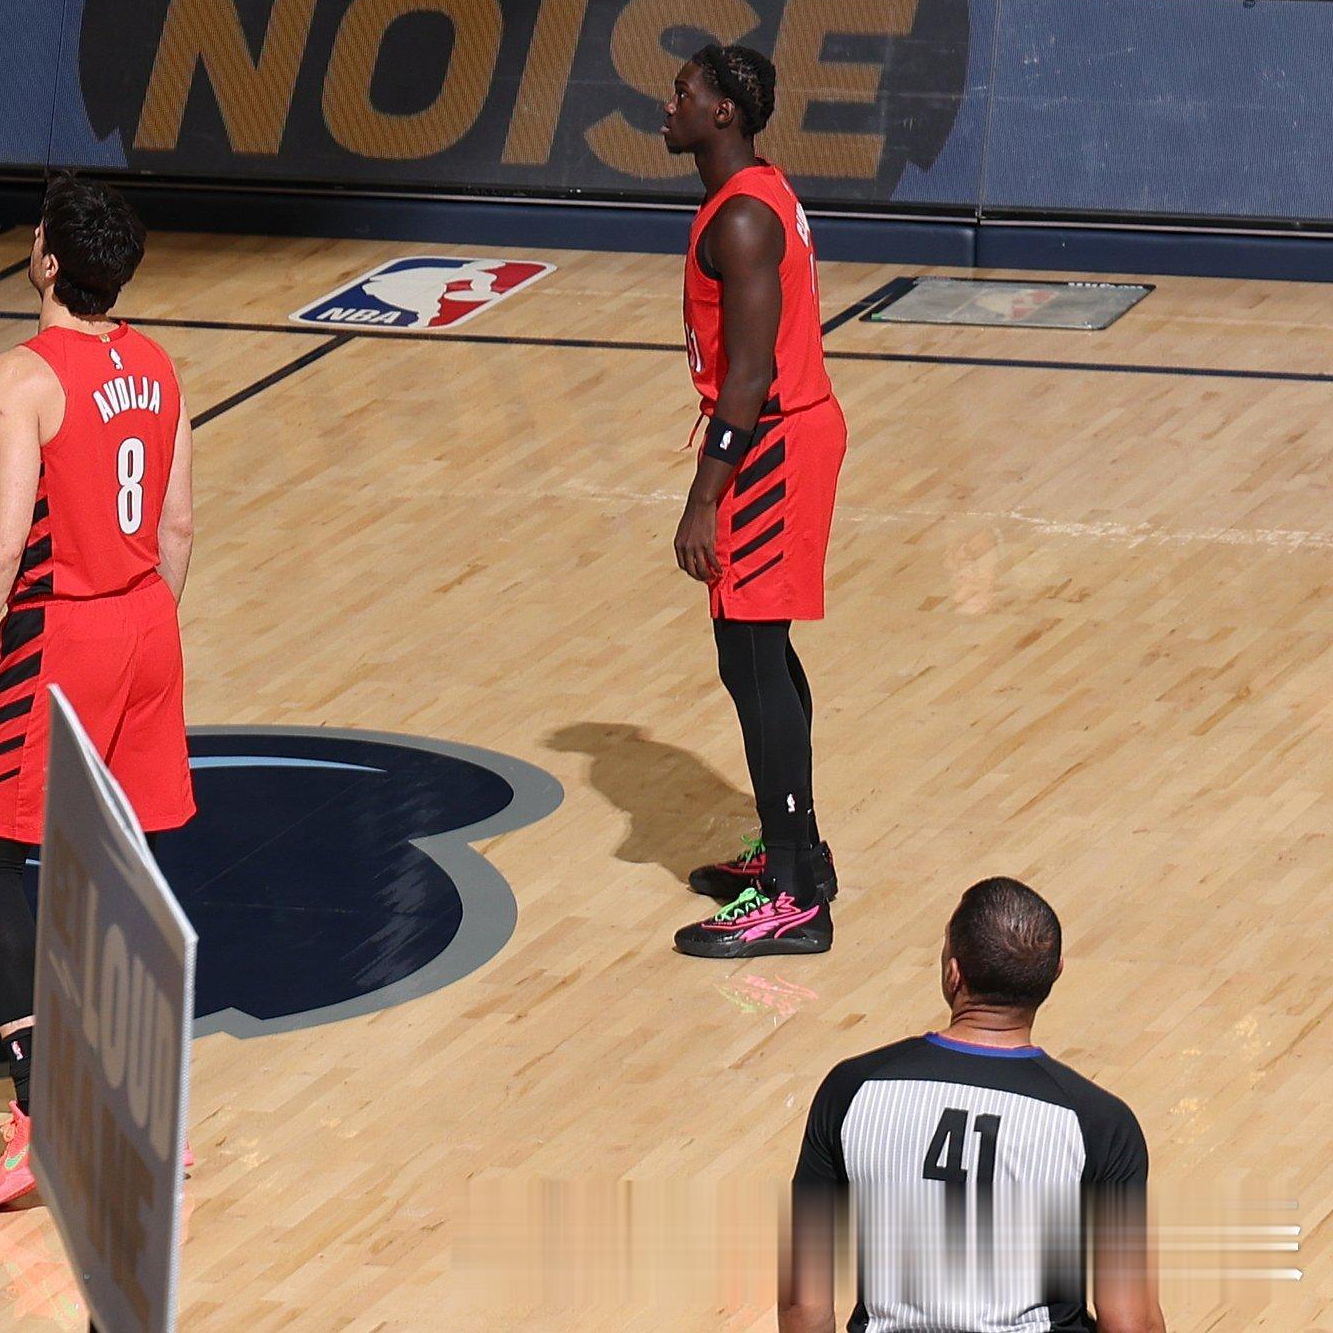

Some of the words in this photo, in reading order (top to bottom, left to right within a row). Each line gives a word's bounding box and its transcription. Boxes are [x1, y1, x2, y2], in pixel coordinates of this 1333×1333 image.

[315, 306, 403, 325] NBA
[93, 374, 162, 424] AVDIJA
[116, 437, 146, 535] 8
[921, 1108, 1001, 1185] 41
